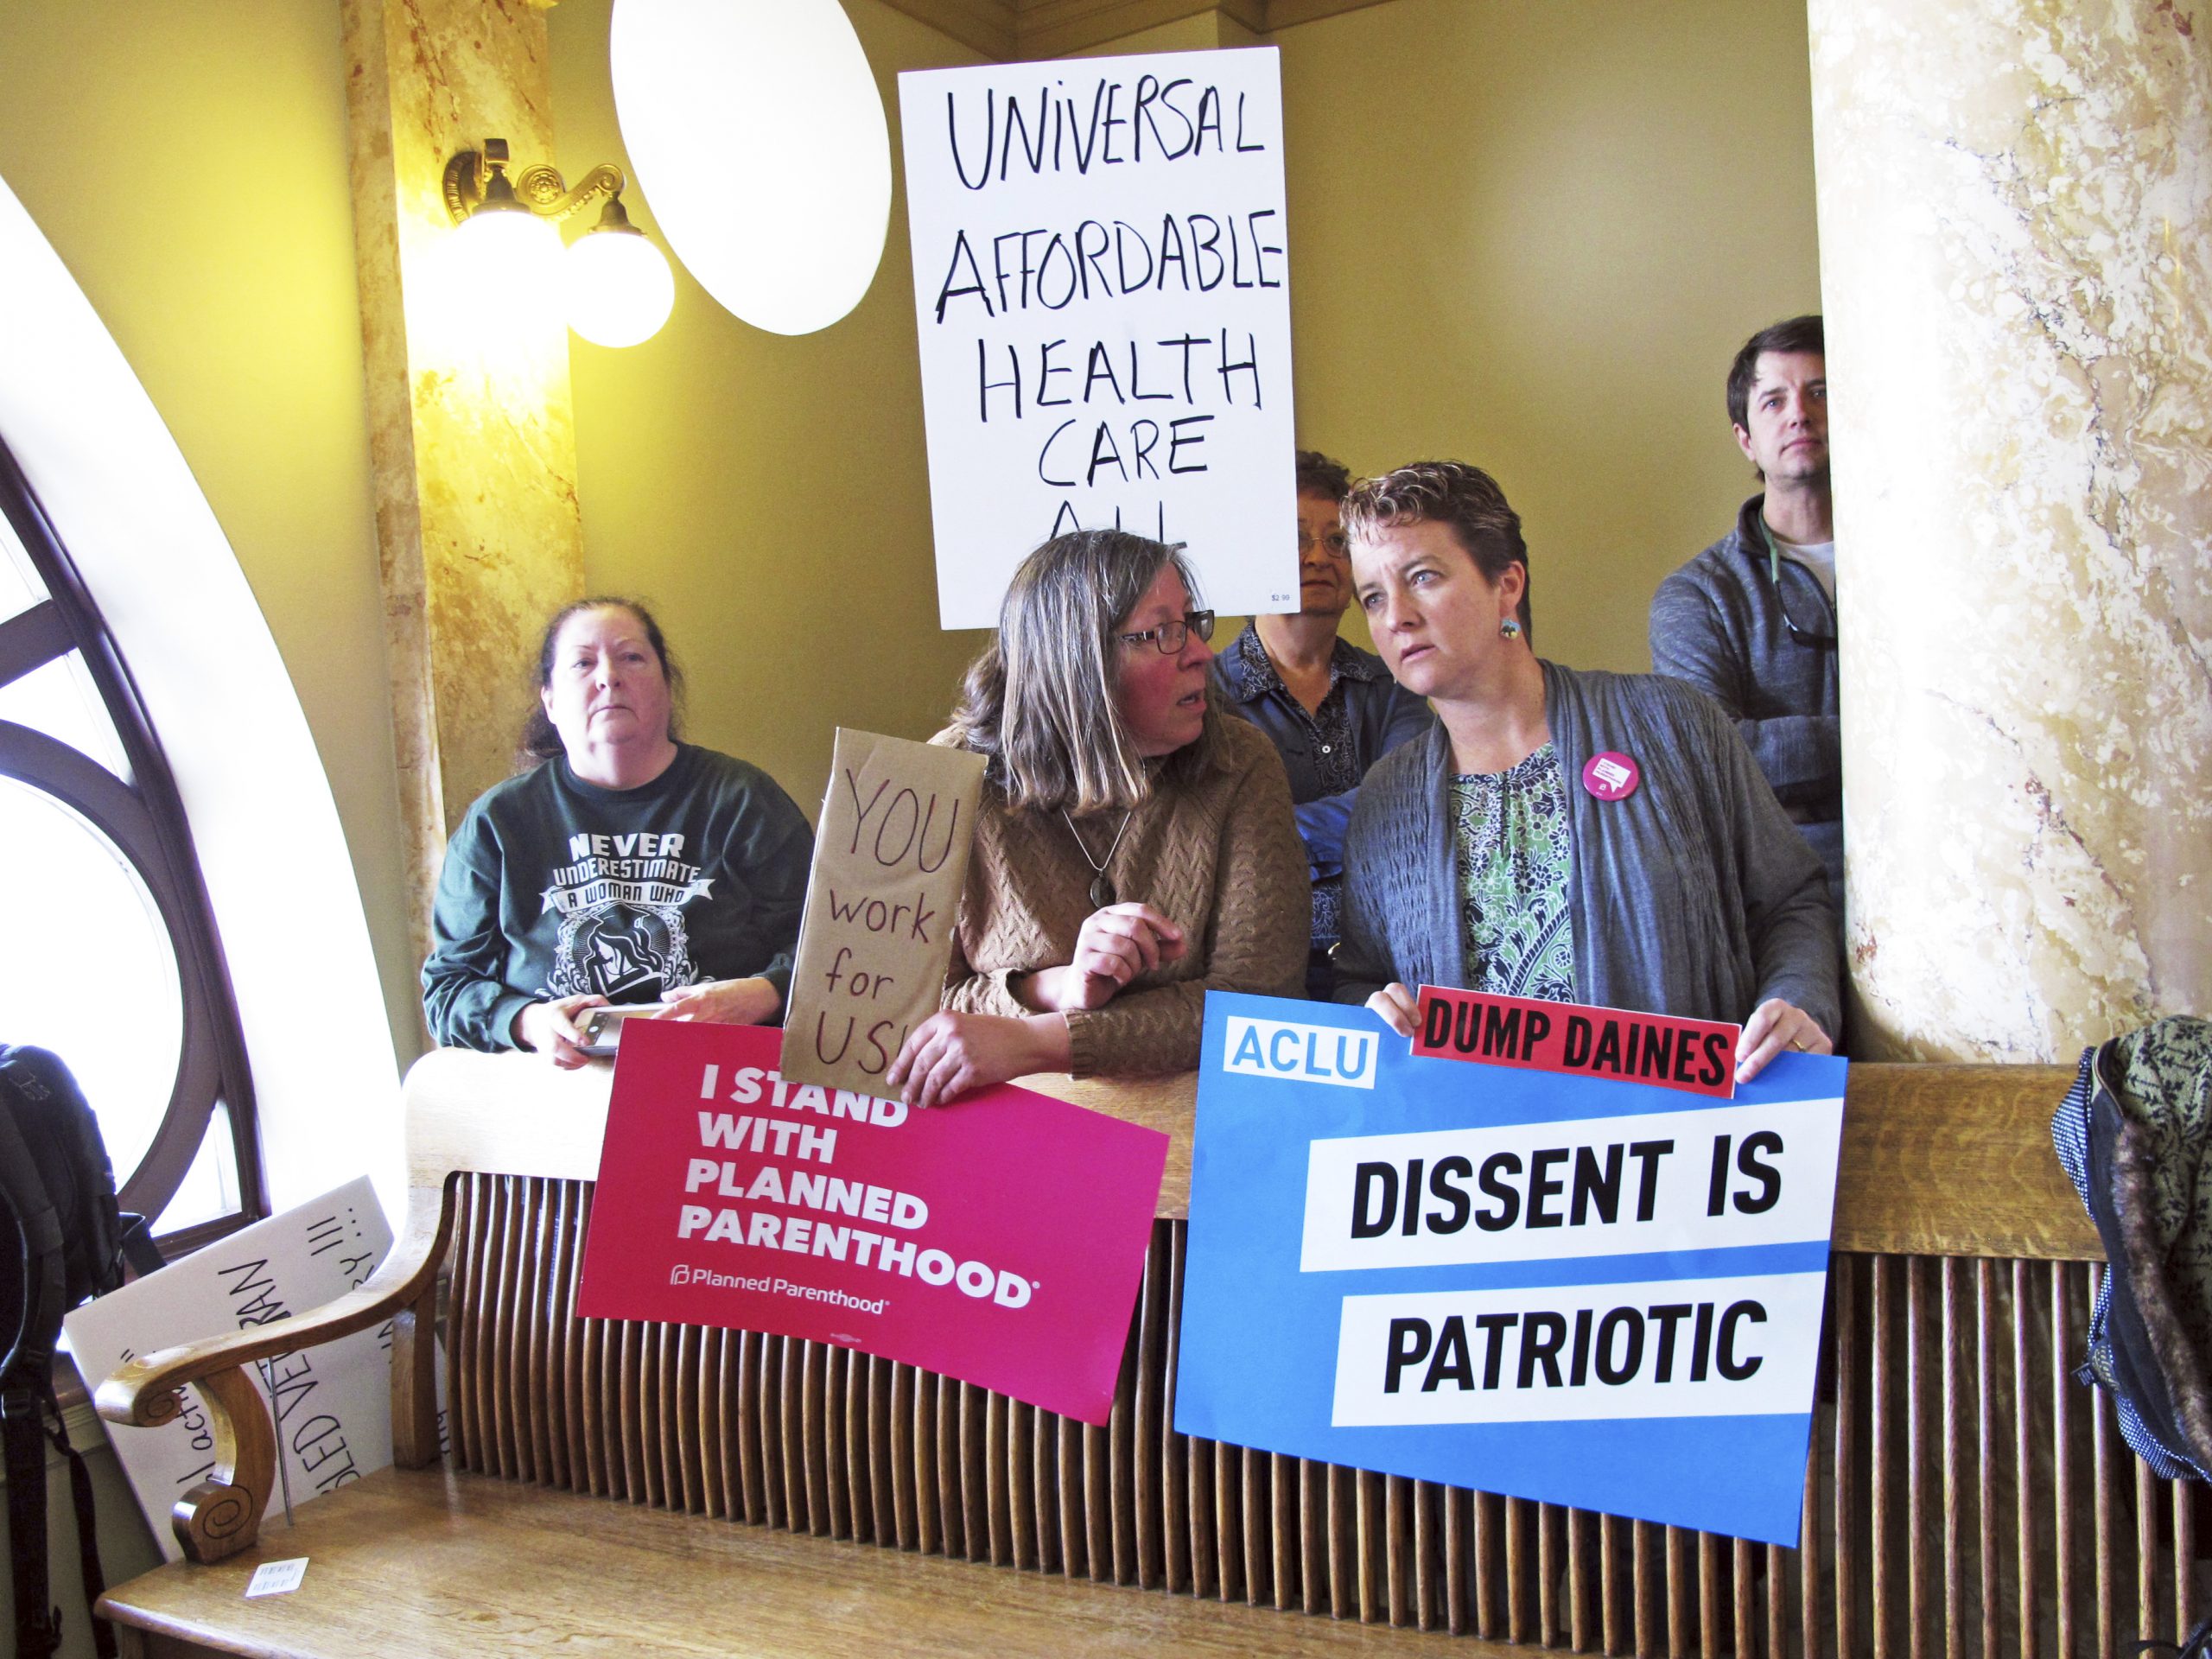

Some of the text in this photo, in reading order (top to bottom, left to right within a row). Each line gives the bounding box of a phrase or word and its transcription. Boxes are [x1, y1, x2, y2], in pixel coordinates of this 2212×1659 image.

[935, 210, 1282, 323] AFFORDABLE
[978, 327, 1262, 422] HEALTH
[1038, 415, 1215, 487] CARE
[569, 833, 685, 862] NEVER
[845, 768, 959, 873] YOU
[553, 858, 702, 887] UNDERESTIMATE
[567, 882, 685, 907] A WOMAN WHO
[830, 889, 935, 944] work
[825, 947, 893, 1000] for
[1231, 1025, 1369, 1081] ACLU
[1423, 997, 1729, 1087] DUMP DAINES
[701, 1064, 720, 1100] I
[698, 1111, 838, 1164] WITH
[684, 1159, 929, 1230] PLANNED
[1351, 1130, 1785, 1239] DISSENT IS
[692, 1268, 771, 1294] Planned
[1383, 1299, 1769, 1395] PATRIOTIC
